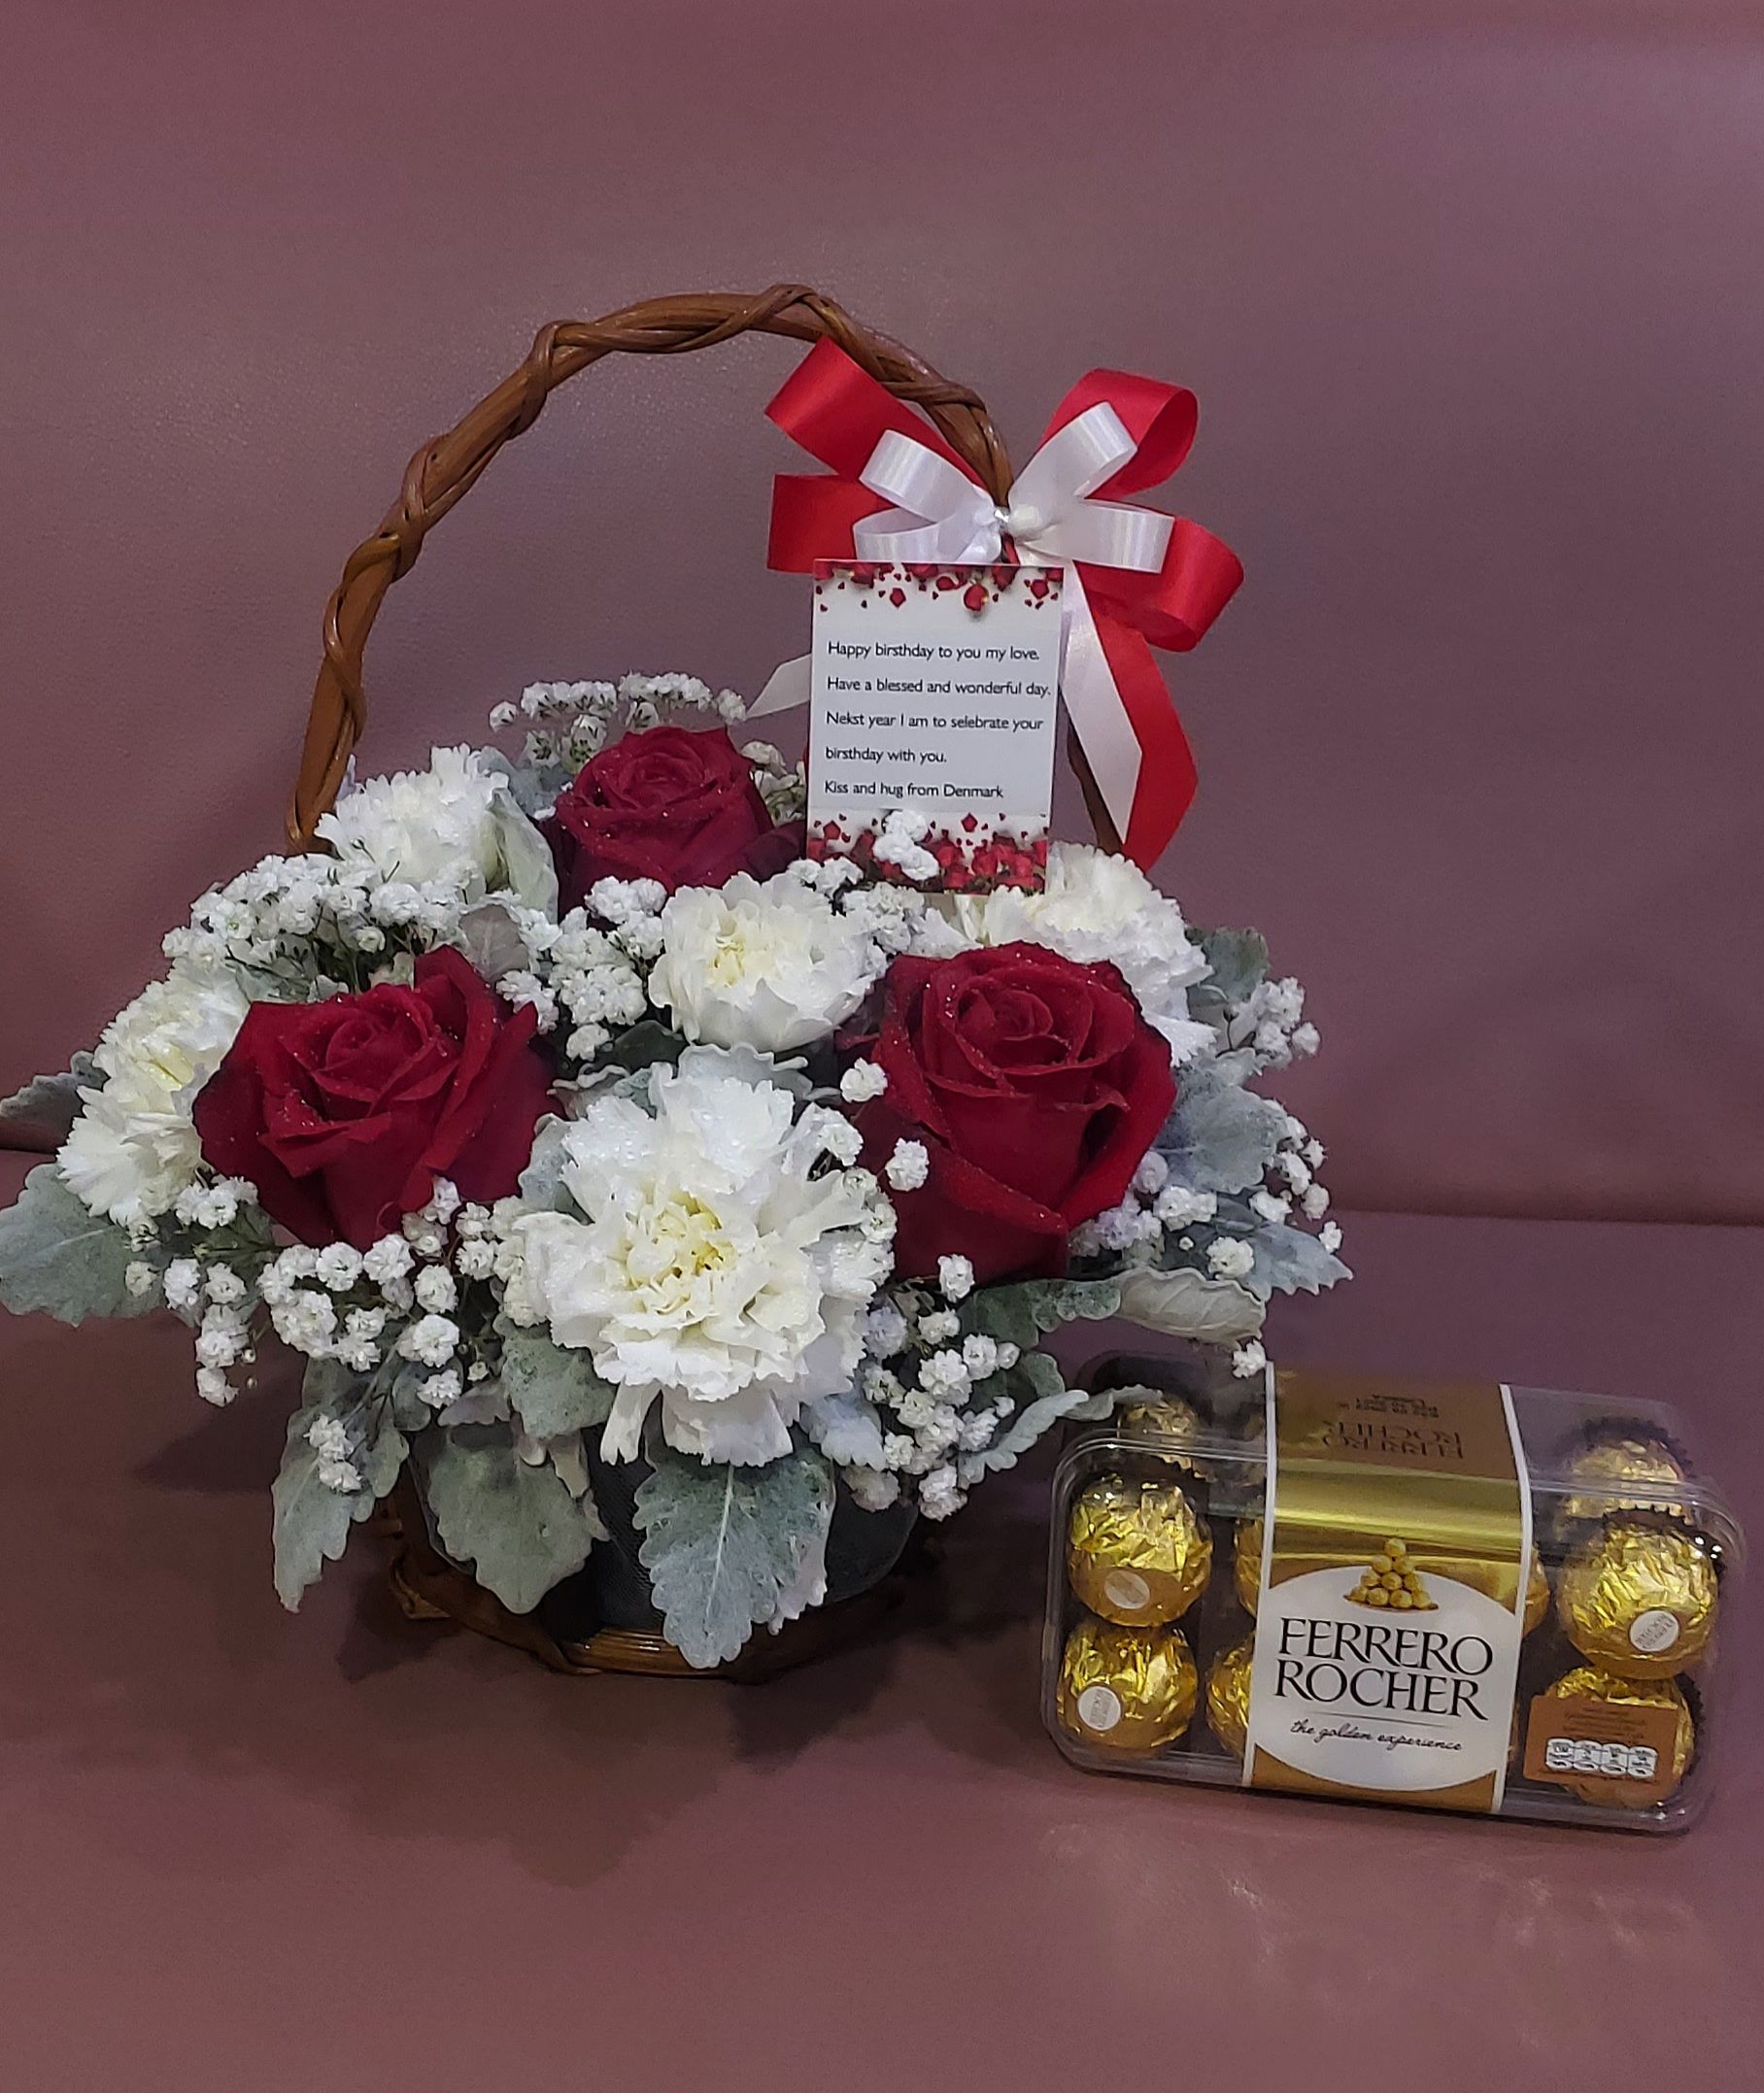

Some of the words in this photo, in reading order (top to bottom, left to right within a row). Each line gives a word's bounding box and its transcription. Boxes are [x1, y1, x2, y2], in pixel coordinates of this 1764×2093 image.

[828, 640, 872, 660] Happy
[938, 646, 953, 658] to
[956, 648, 981, 662] you
[985, 649, 1006, 662] my
[1009, 645, 1040, 660] love.
[827, 675, 862, 692] Have
[865, 681, 872, 692] a
[876, 677, 924, 692] blessed
[927, 680, 952, 693] and
[954, 680, 1023, 695] wonderful
[1025, 681, 1051, 699] day.
[826, 710, 865, 726] Nekst
[867, 716, 897, 729] year
[900, 713, 904, 727] I
[908, 717, 929, 728] am
[933, 716, 947, 728] to
[950, 715, 1009, 729] selebrate
[1012, 719, 1044, 733] your
[886, 748, 916, 762] with
[919, 752, 947, 766] you.
[824, 780, 849, 794] Kiss
[852, 781, 876, 795] and
[880, 781, 904, 799] hug
[906, 782, 939, 797] from
[943, 783, 1004, 798] Denmark
[1278, 1616, 1493, 1676] FERRERO
[1274, 1658, 1489, 1722] ROCHER
[1289, 1718, 1316, 1735] the
[1317, 1722, 1374, 1743] golden
[1376, 1734, 1462, 1751] experience
